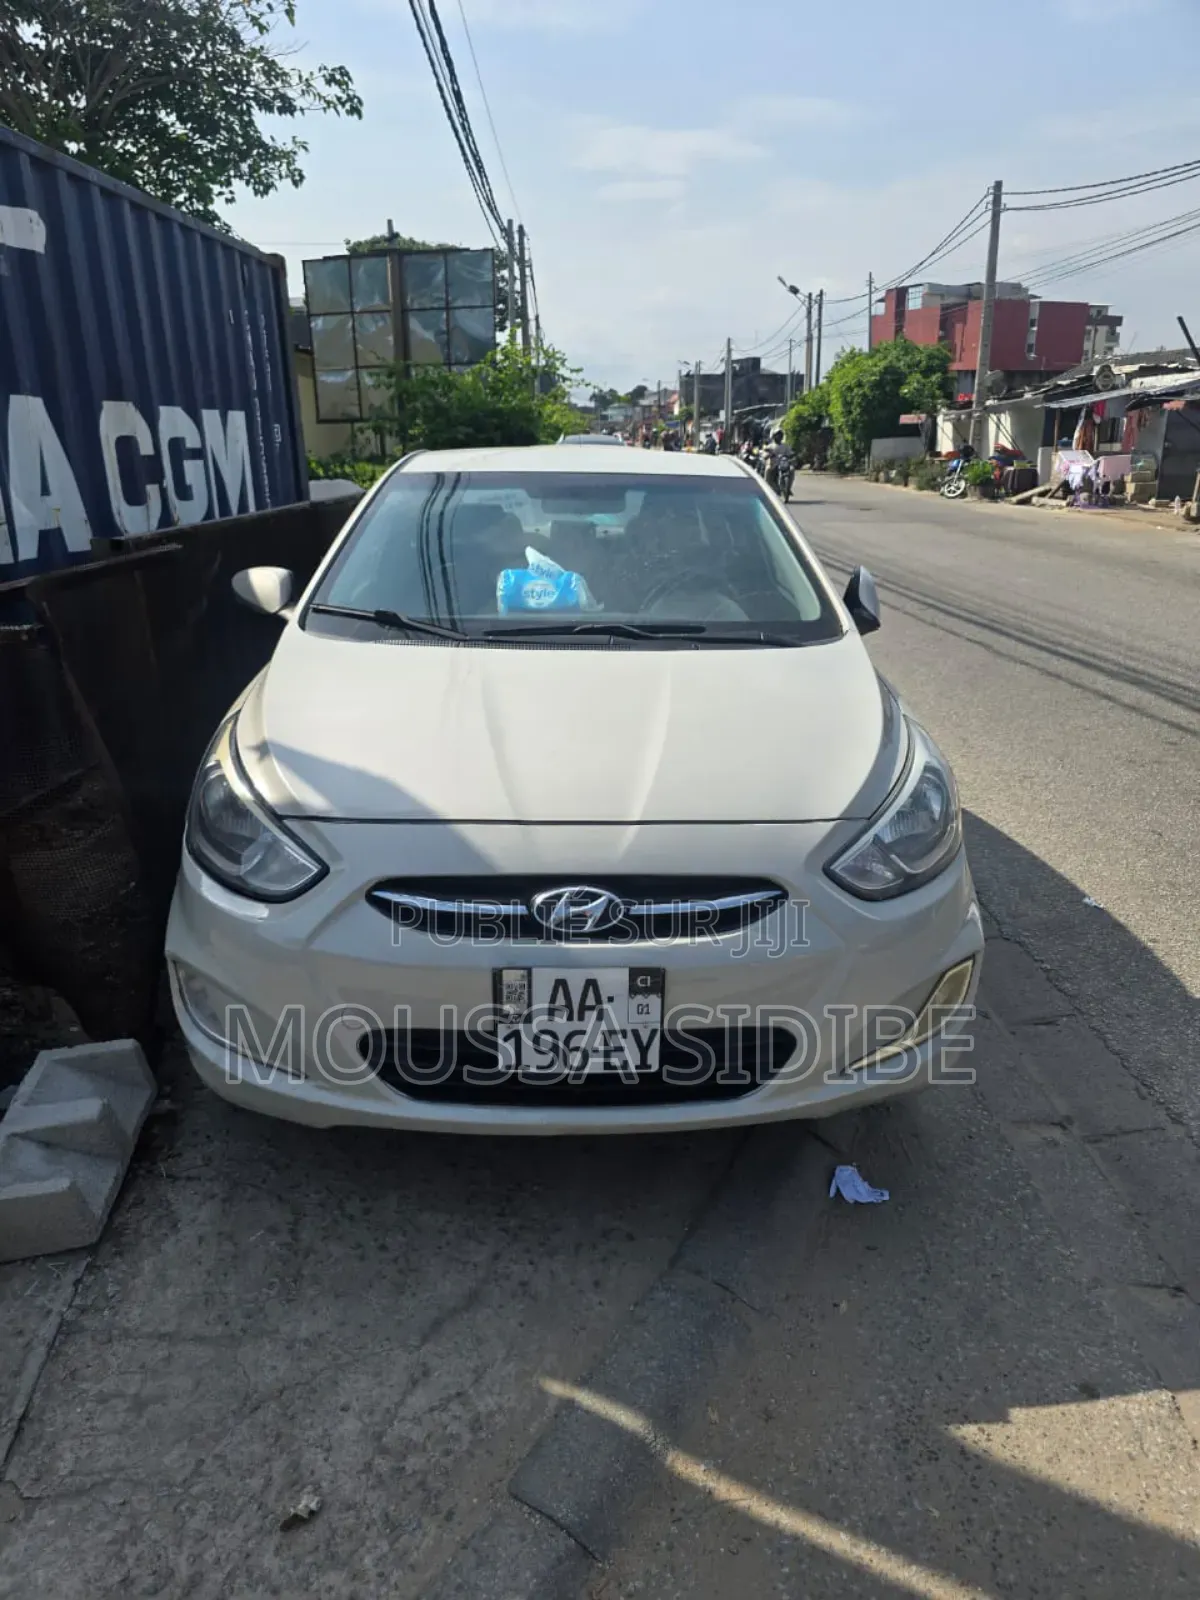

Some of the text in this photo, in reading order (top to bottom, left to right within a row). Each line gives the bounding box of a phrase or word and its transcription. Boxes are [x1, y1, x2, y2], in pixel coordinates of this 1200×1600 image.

[0, 394, 92, 562] A
[99, 400, 256, 538] CGM
[523, 588, 557, 601] style
